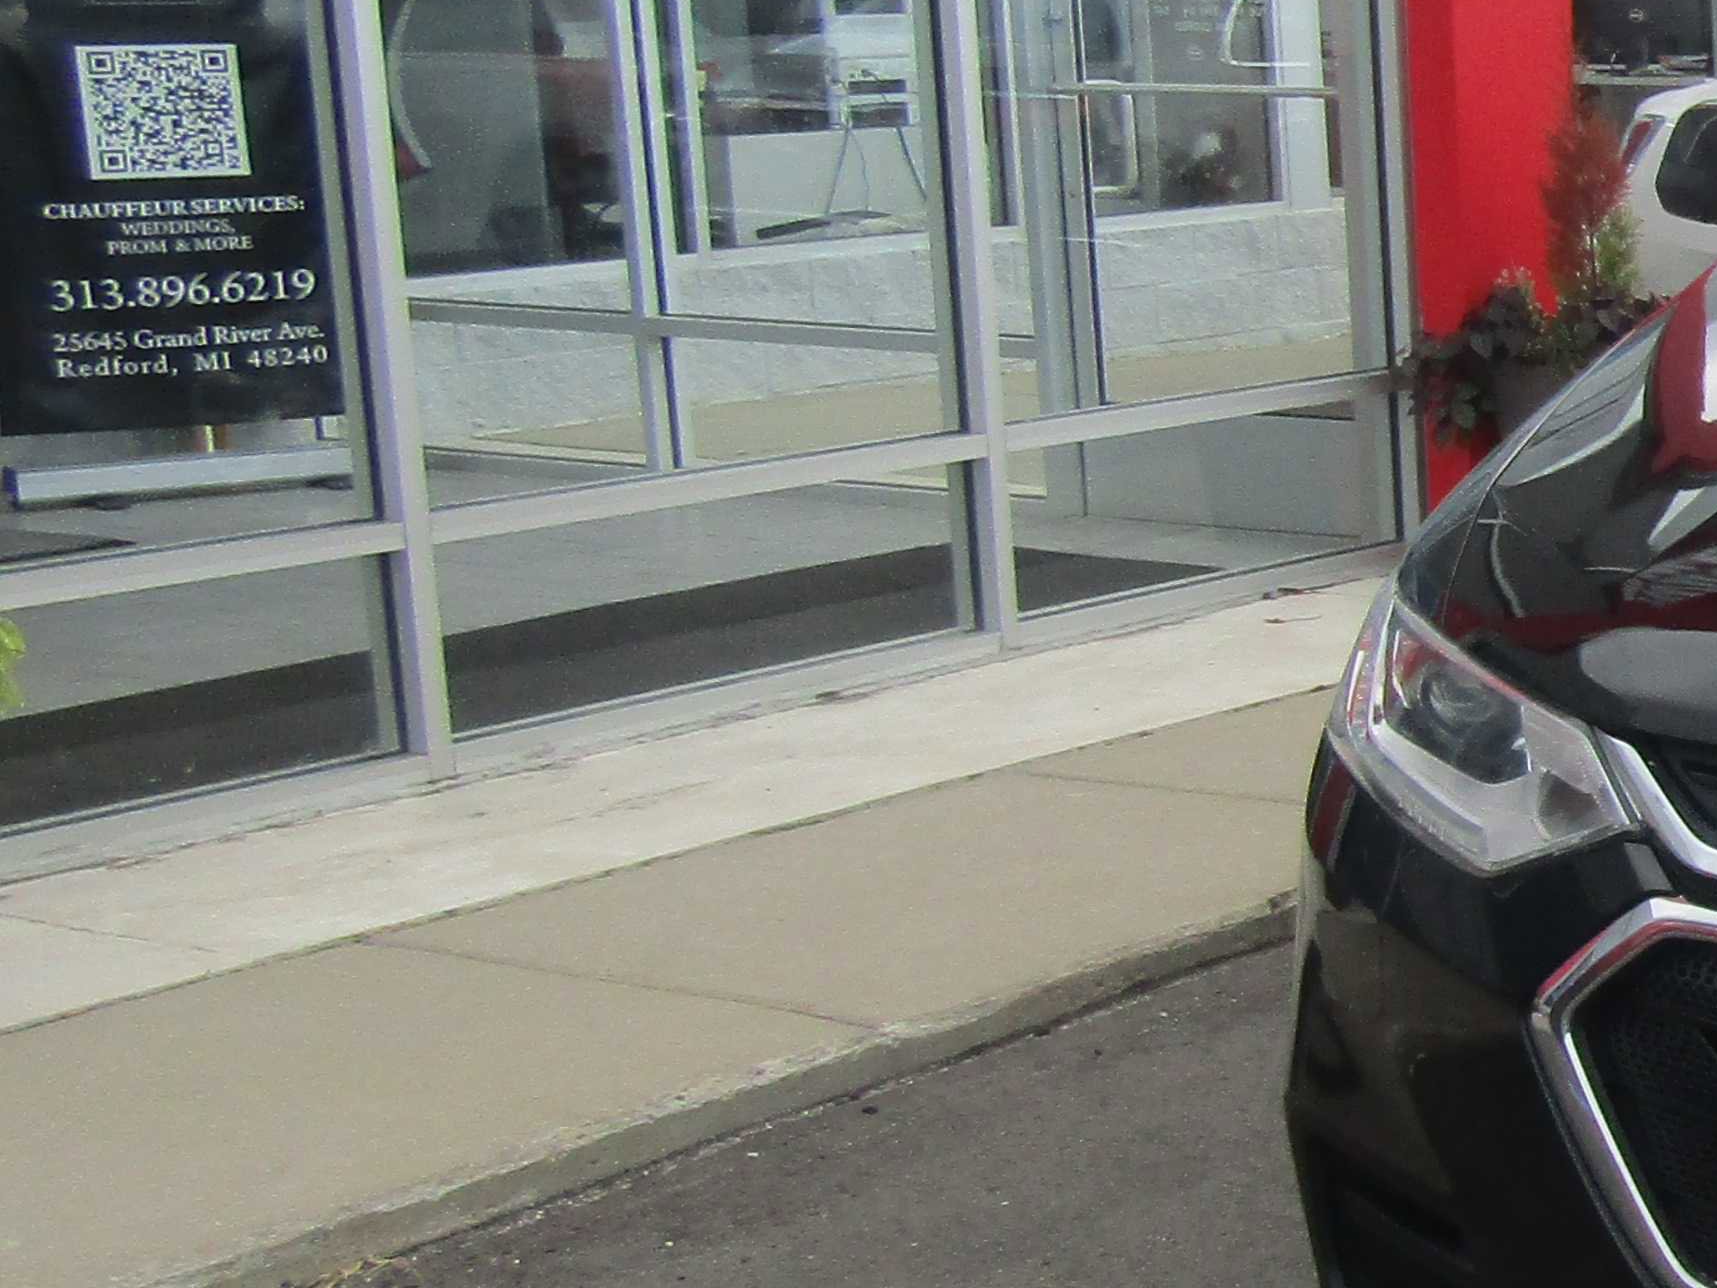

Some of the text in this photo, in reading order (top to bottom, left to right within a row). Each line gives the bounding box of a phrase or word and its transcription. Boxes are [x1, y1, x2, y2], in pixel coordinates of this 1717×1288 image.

[43, 196, 305, 220] CHAUFFEUR SERVICES:
[120, 219, 236, 236] WEDDINGS,
[106, 235, 254, 256] PROM & MORE
[50, 268, 316, 312] 313.896.6219
[53, 321, 325, 352] 25645 Grand River Ave.
[56, 344, 328, 379] Redford, MI 48240
